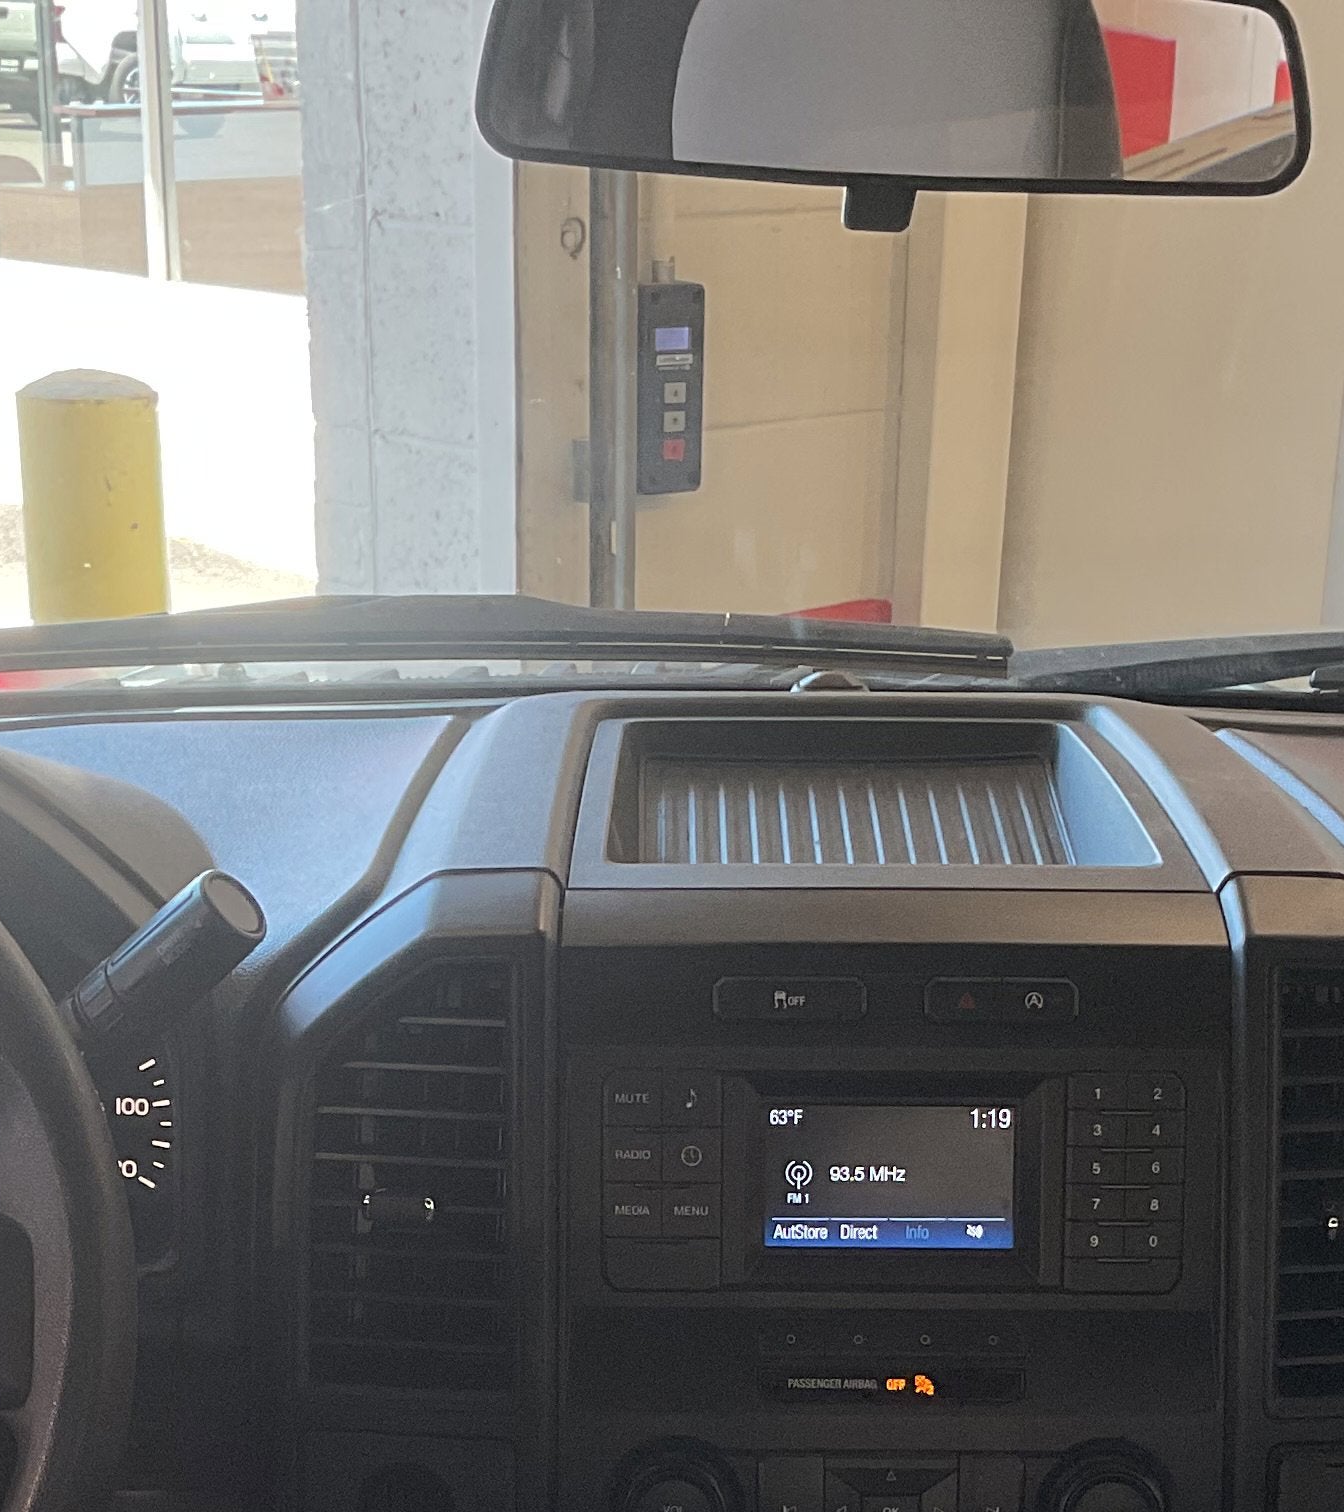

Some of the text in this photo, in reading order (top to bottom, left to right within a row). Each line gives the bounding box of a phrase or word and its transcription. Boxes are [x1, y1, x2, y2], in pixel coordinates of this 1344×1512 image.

[614, 1092, 650, 1104] MUTE
[1094, 1088, 1101, 1100] 1
[1153, 1088, 1162, 1100] 2
[116, 1097, 149, 1116] 100
[769, 1108, 803, 1127] 63°F
[970, 1108, 1011, 1130] 1:19
[1092, 1125, 1102, 1137] 3
[1151, 1125, 1161, 1137] 4
[615, 1149, 651, 1160] RADIO
[1092, 1163, 1101, 1174] 5
[1151, 1162, 1161, 1174] 6
[829, 1166, 906, 1183] 93.5 MHz
[787, 1193, 802, 1204] FM
[614, 1205, 650, 1217] MEDIA
[673, 1205, 709, 1217] MENU
[1092, 1199, 1100, 1211] 7
[1150, 1199, 1159, 1211] 8
[773, 1224, 929, 1241] AutStore Direct Info
[1090, 1236, 1099, 1247] 9
[1148, 1236, 1158, 1247] 0
[787, 1377, 906, 1391] PASSENGER AIRBAG OFF
